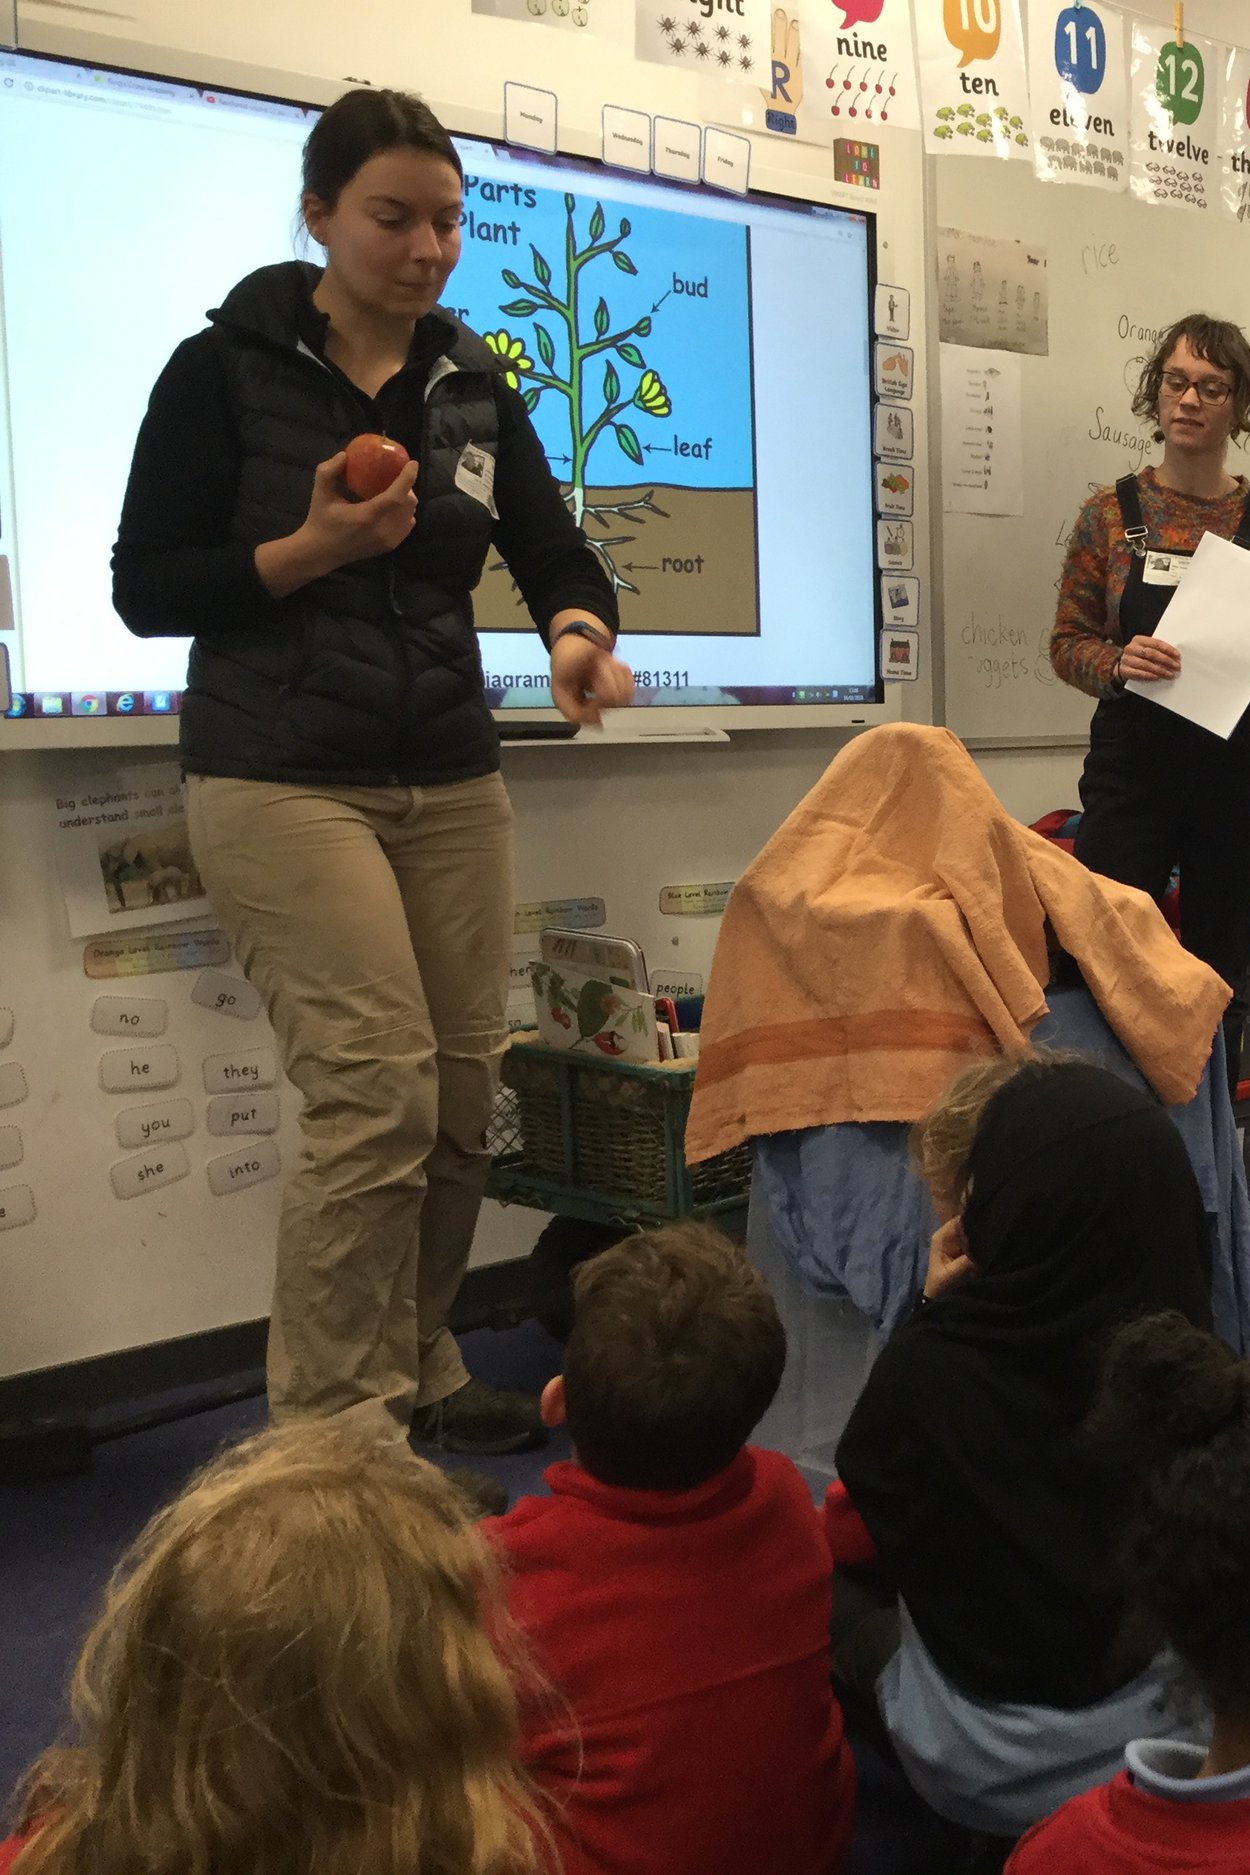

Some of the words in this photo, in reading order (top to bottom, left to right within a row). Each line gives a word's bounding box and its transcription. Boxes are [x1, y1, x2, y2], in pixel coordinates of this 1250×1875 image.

[958, 0, 997, 34] 10
[837, 32, 888, 61] nine
[1064, 21, 1098, 69] 11
[771, 60, 793, 103] R
[960, 72, 999, 96] ten
[1164, 54, 1199, 103] 12
[767, 113, 796, 132] Right
[612, 132, 643, 146] Wednesday
[665, 147, 690, 159] Thursday
[1080, 233, 1120, 275] rice
[672, 272, 709, 300] bud
[673, 435, 713, 459] leaf
[1088, 406, 1151, 471] Sausage
[661, 555, 705, 574] root
[961, 611, 1029, 646] chicken
[484, 671, 550, 688] iagram
[633, 670, 690, 688] #81311
[56, 798, 76, 811] Big
[81, 791, 139, 809] elephants
[59, 809, 129, 829] understand
[656, 982, 695, 997] people
[215, 992, 236, 1008] go
[119, 1013, 140, 1026] no
[130, 1061, 150, 1075] he
[223, 1063, 259, 1080] they
[141, 1117, 171, 1138] you
[230, 1109, 257, 1126] put
[137, 1161, 164, 1181] she
[229, 1160, 260, 1179] into
